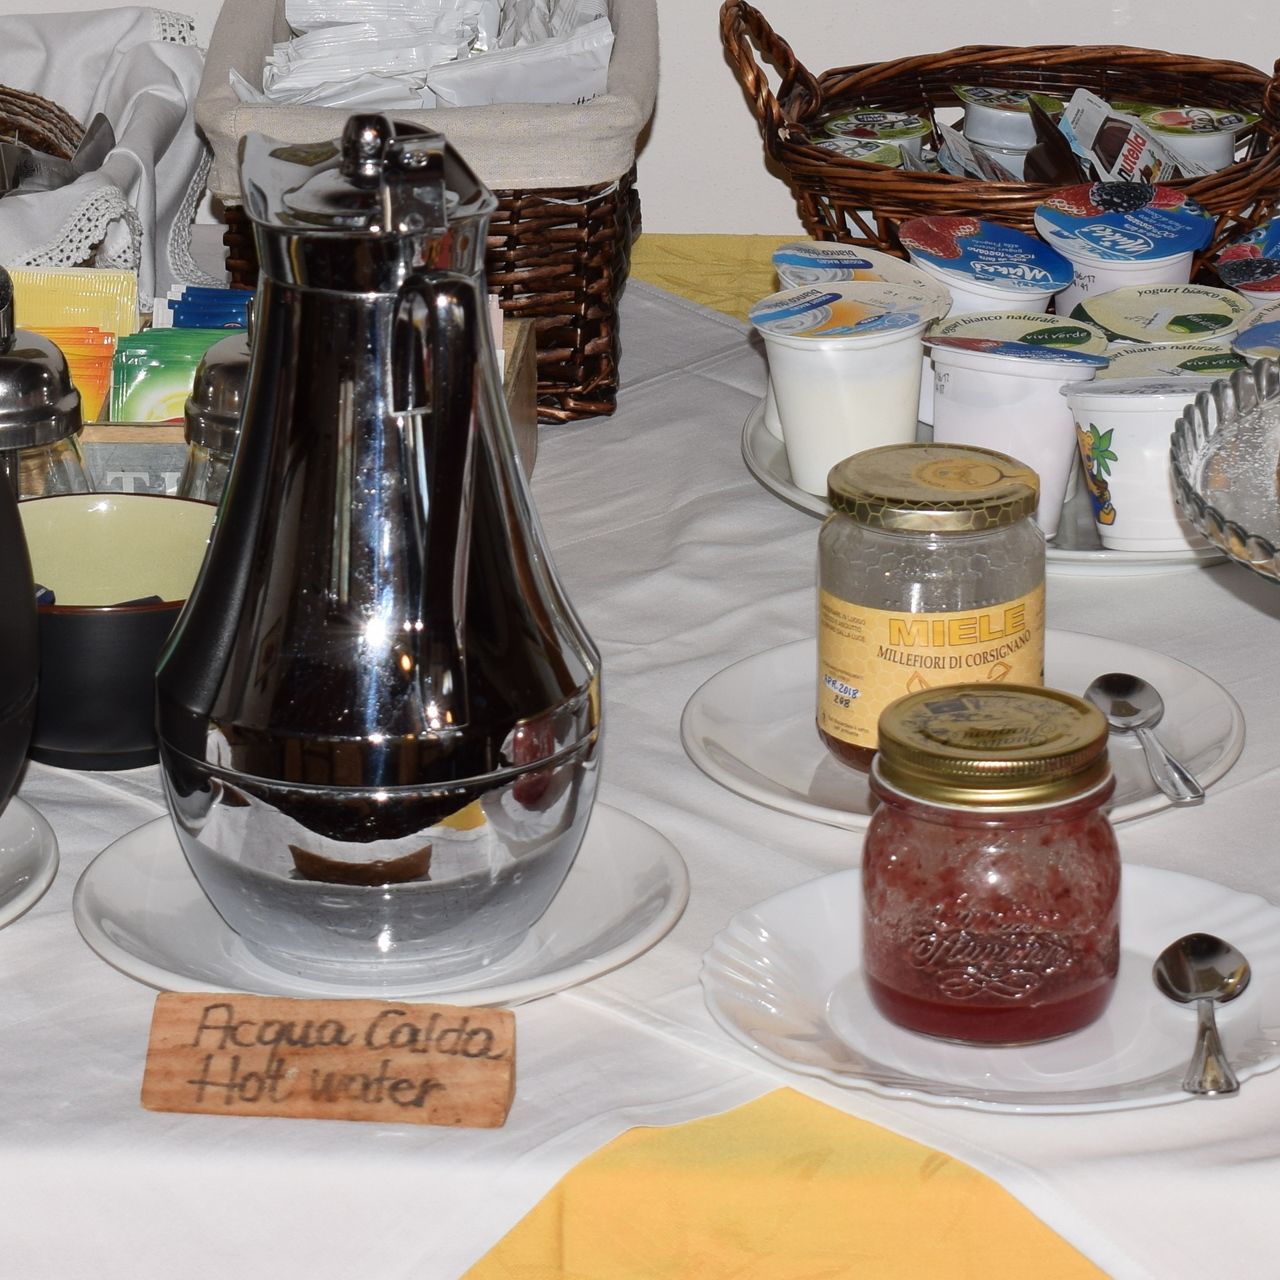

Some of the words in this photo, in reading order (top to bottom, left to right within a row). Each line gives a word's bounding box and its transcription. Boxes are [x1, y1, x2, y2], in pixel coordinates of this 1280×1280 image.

[1117, 132, 1148, 181] nutella
[822, 249, 857, 258] bianco
[788, 289, 824, 304] bianco
[1136, 287, 1180, 297] yogurt
[1181, 288, 1220, 299] bianco
[964, 315, 1003, 325] bianco
[1006, 314, 1060, 324] naturale
[1026, 332, 1050, 340] vivi
[1051, 326, 1088, 339] verde
[1124, 346, 1167, 355] bianco
[1170, 344, 1224, 353] naturale
[888, 603, 1026, 647] MIELE
[877, 644, 946, 670] MILLEFIORI
[949, 656, 963, 668] DI
[966, 628, 1032, 667] CORSIGNANO
[190, 1002, 355, 1058] Acqua
[364, 1009, 508, 1060] Calda
[187, 1053, 290, 1106] Hot
[310, 1058, 446, 1108] water
